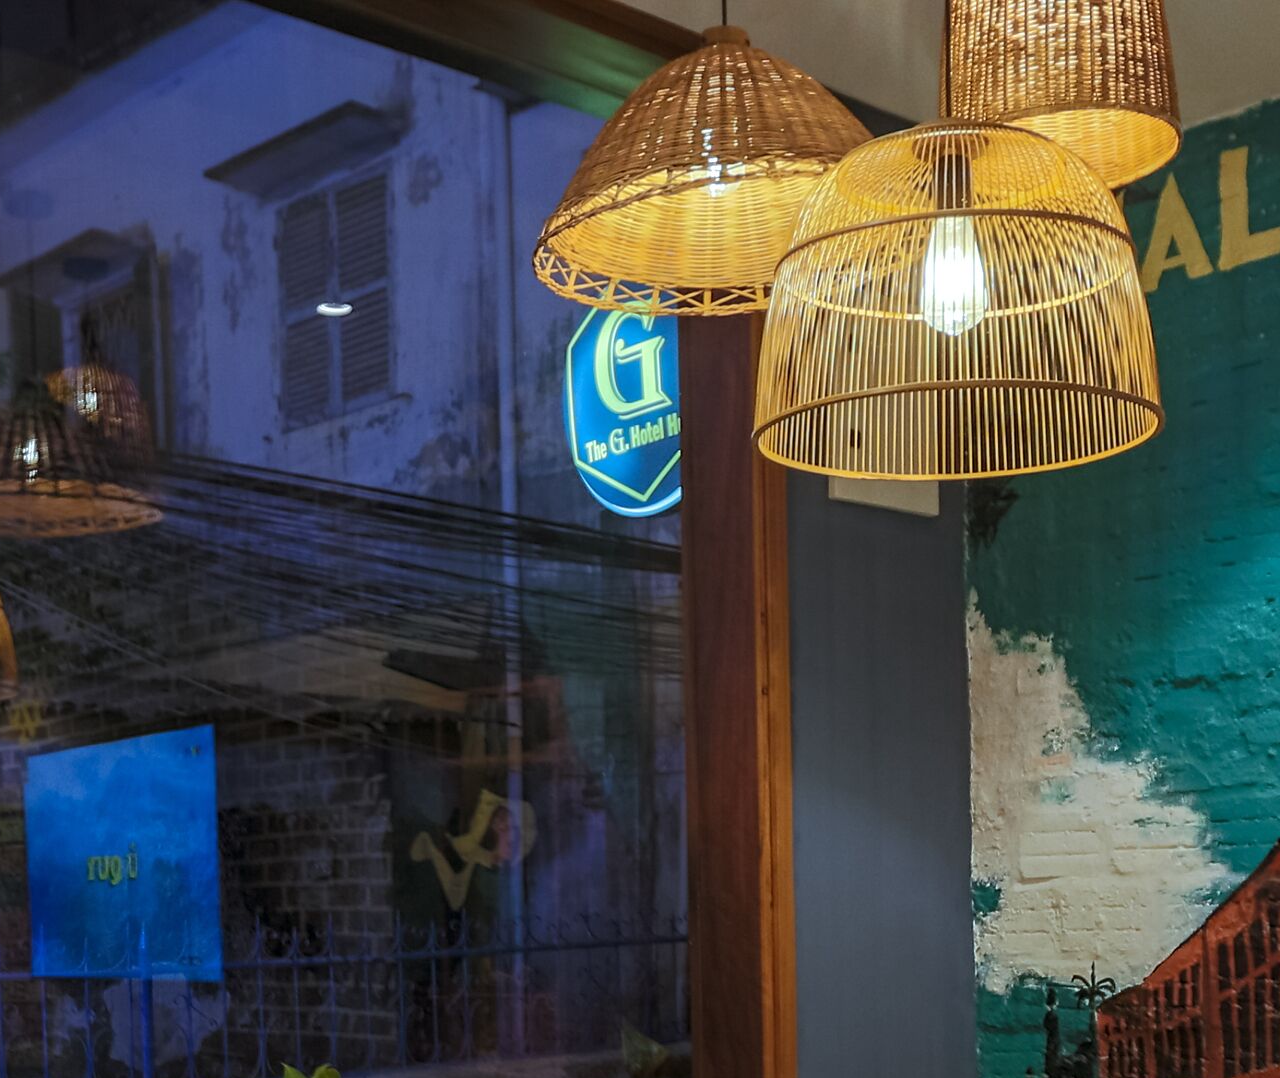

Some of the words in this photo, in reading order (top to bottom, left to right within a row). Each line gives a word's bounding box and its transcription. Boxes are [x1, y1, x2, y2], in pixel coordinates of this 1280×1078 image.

[594, 297, 673, 420] G
[585, 440, 608, 463] The
[609, 428, 630, 455] G.
[629, 416, 665, 448] Hotel
